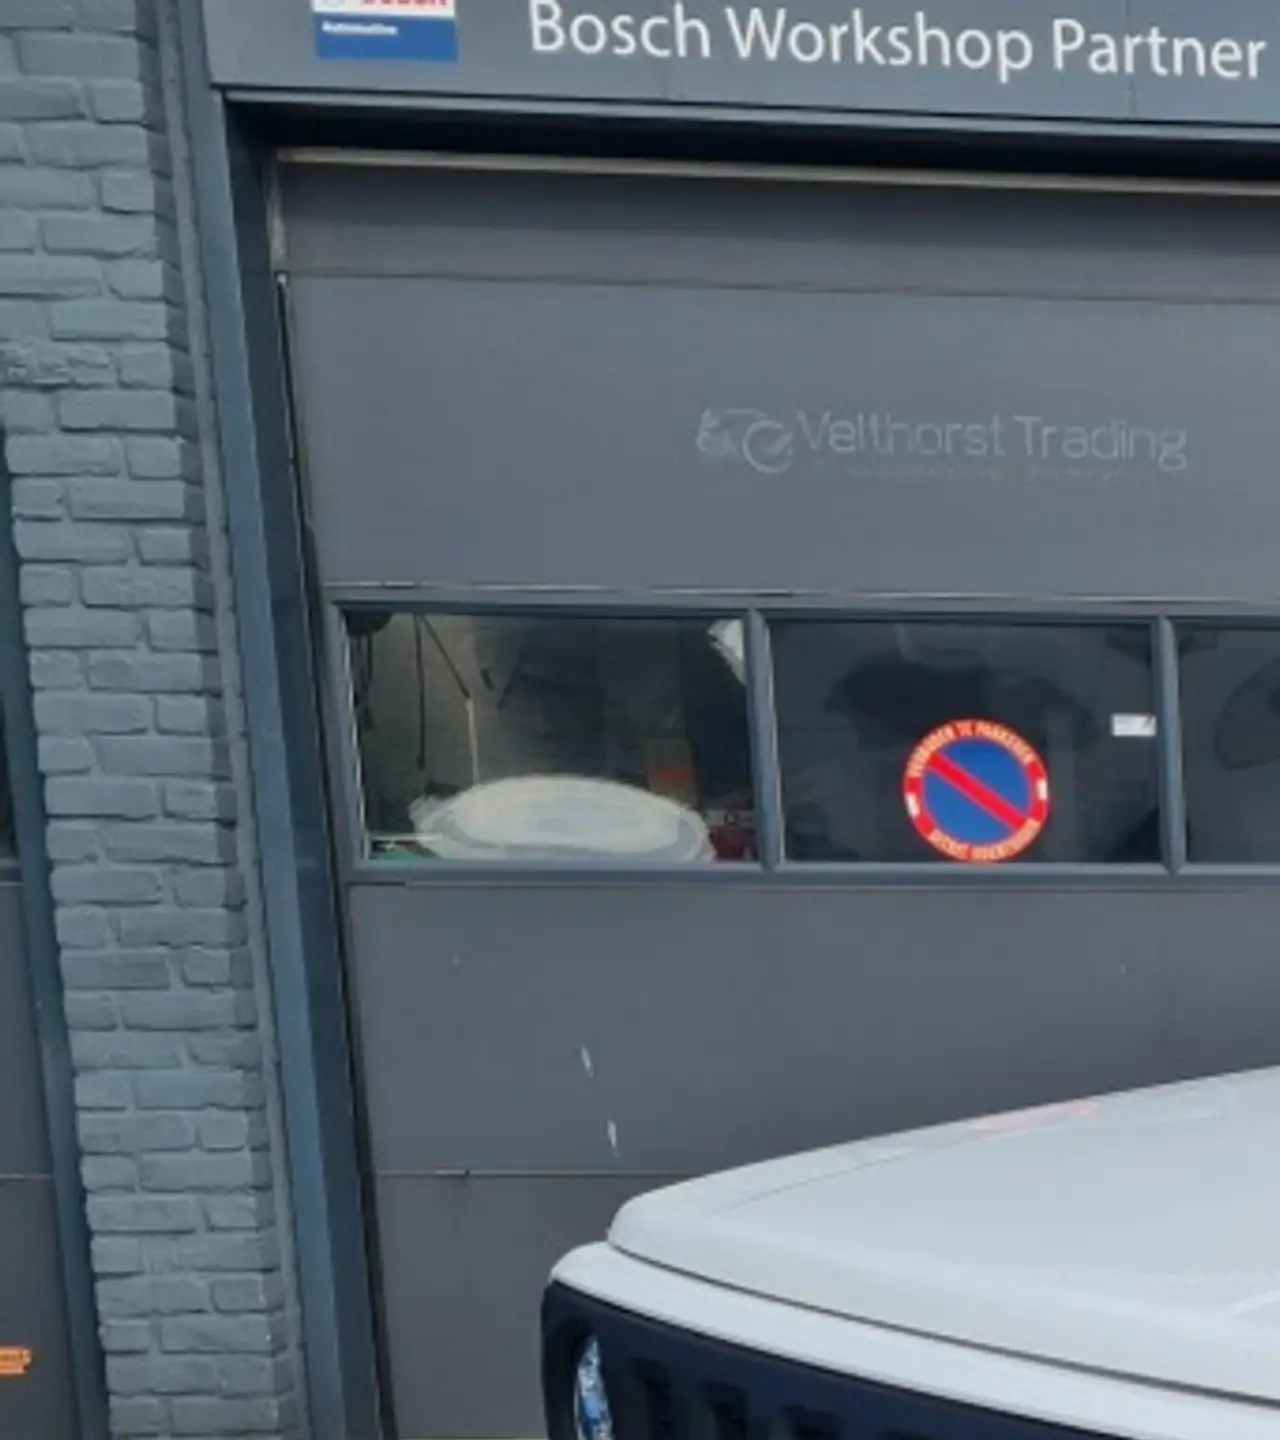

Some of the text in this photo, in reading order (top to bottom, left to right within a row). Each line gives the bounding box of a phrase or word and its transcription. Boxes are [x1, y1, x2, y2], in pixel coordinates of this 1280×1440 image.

[528, 0, 1268, 84] Bosch Workshop Partner
[1013, 414, 1188, 471] Trading
